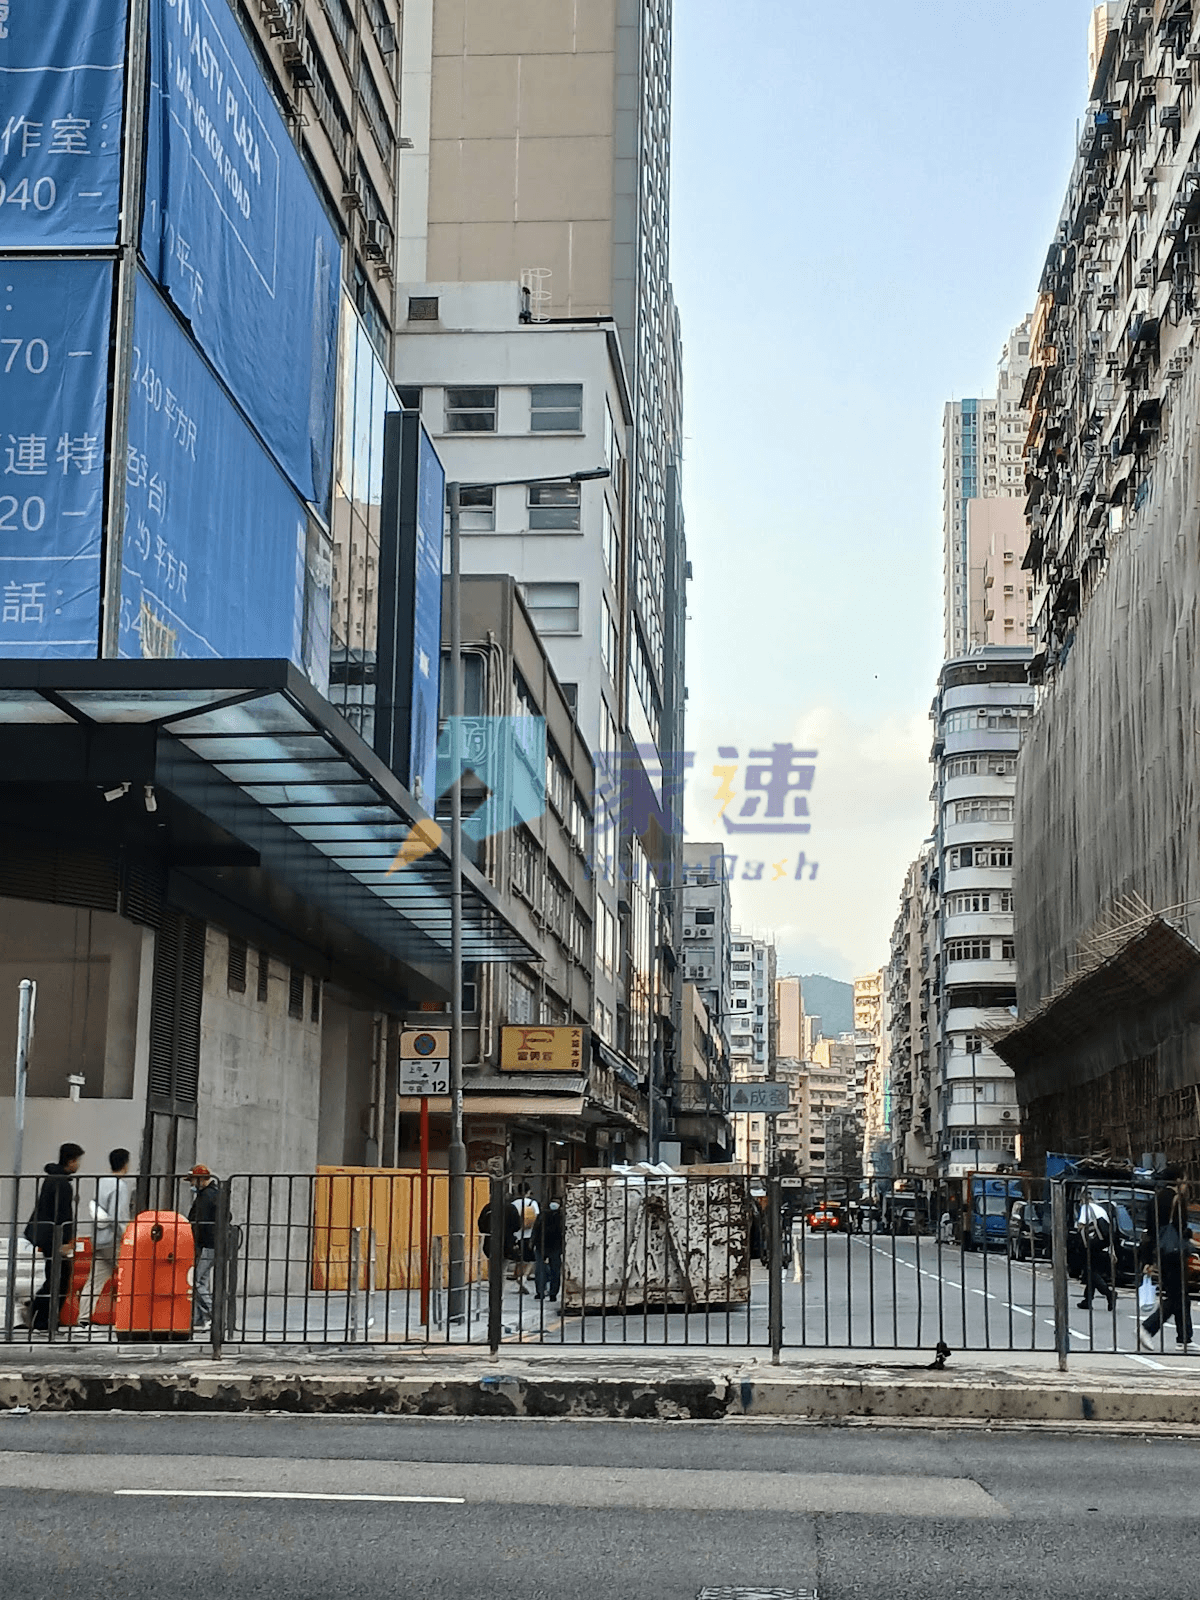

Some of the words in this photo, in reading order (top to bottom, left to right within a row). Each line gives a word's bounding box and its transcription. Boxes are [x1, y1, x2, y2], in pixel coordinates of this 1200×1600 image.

[226, 85, 260, 186] PLAZA
[224, 154, 250, 219] ROAD
[1, 338, 49, 374] 70
[164, 387, 197, 463] 平方尺
[0, 495, 46, 532] 20
[154, 534, 188, 603] 平方尺
[431, 1061, 441, 1073] 7
[431, 1080, 447, 1092] 12
